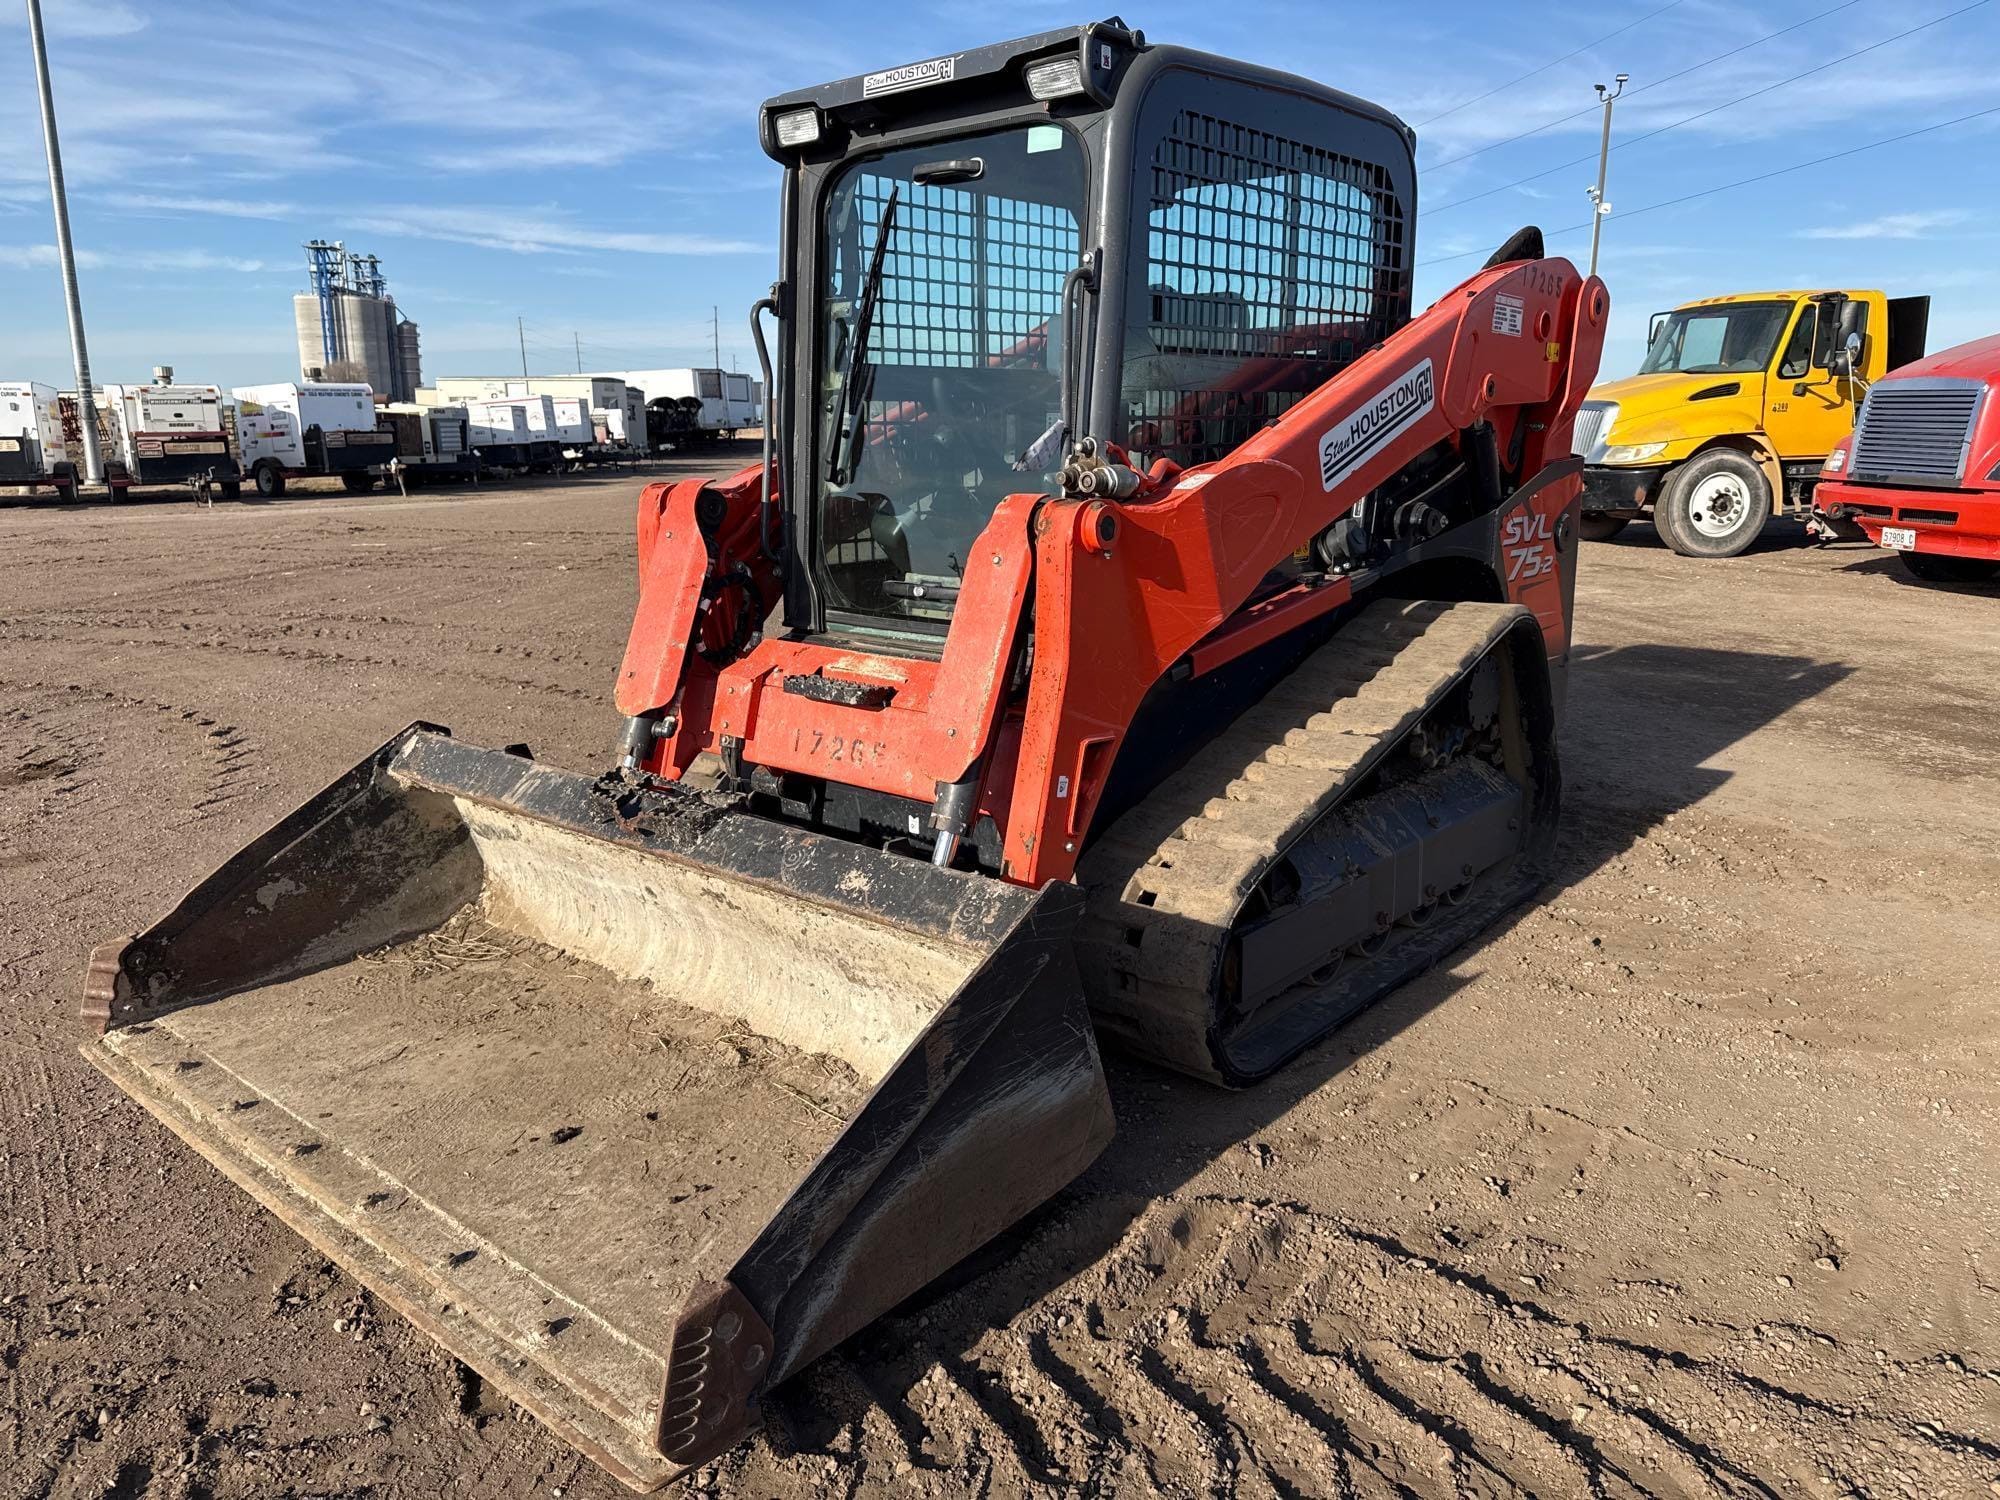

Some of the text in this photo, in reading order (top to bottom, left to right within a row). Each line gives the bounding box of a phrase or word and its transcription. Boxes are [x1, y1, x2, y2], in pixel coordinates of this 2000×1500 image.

[886, 63, 936, 83] HOUSTON
[1522, 266, 1563, 298] 17265
[1322, 436, 1350, 468] Stan
[1350, 380, 1414, 444] HOUSTON
[1503, 513, 1552, 546] SVL
[1883, 531, 1905, 543] 57908
